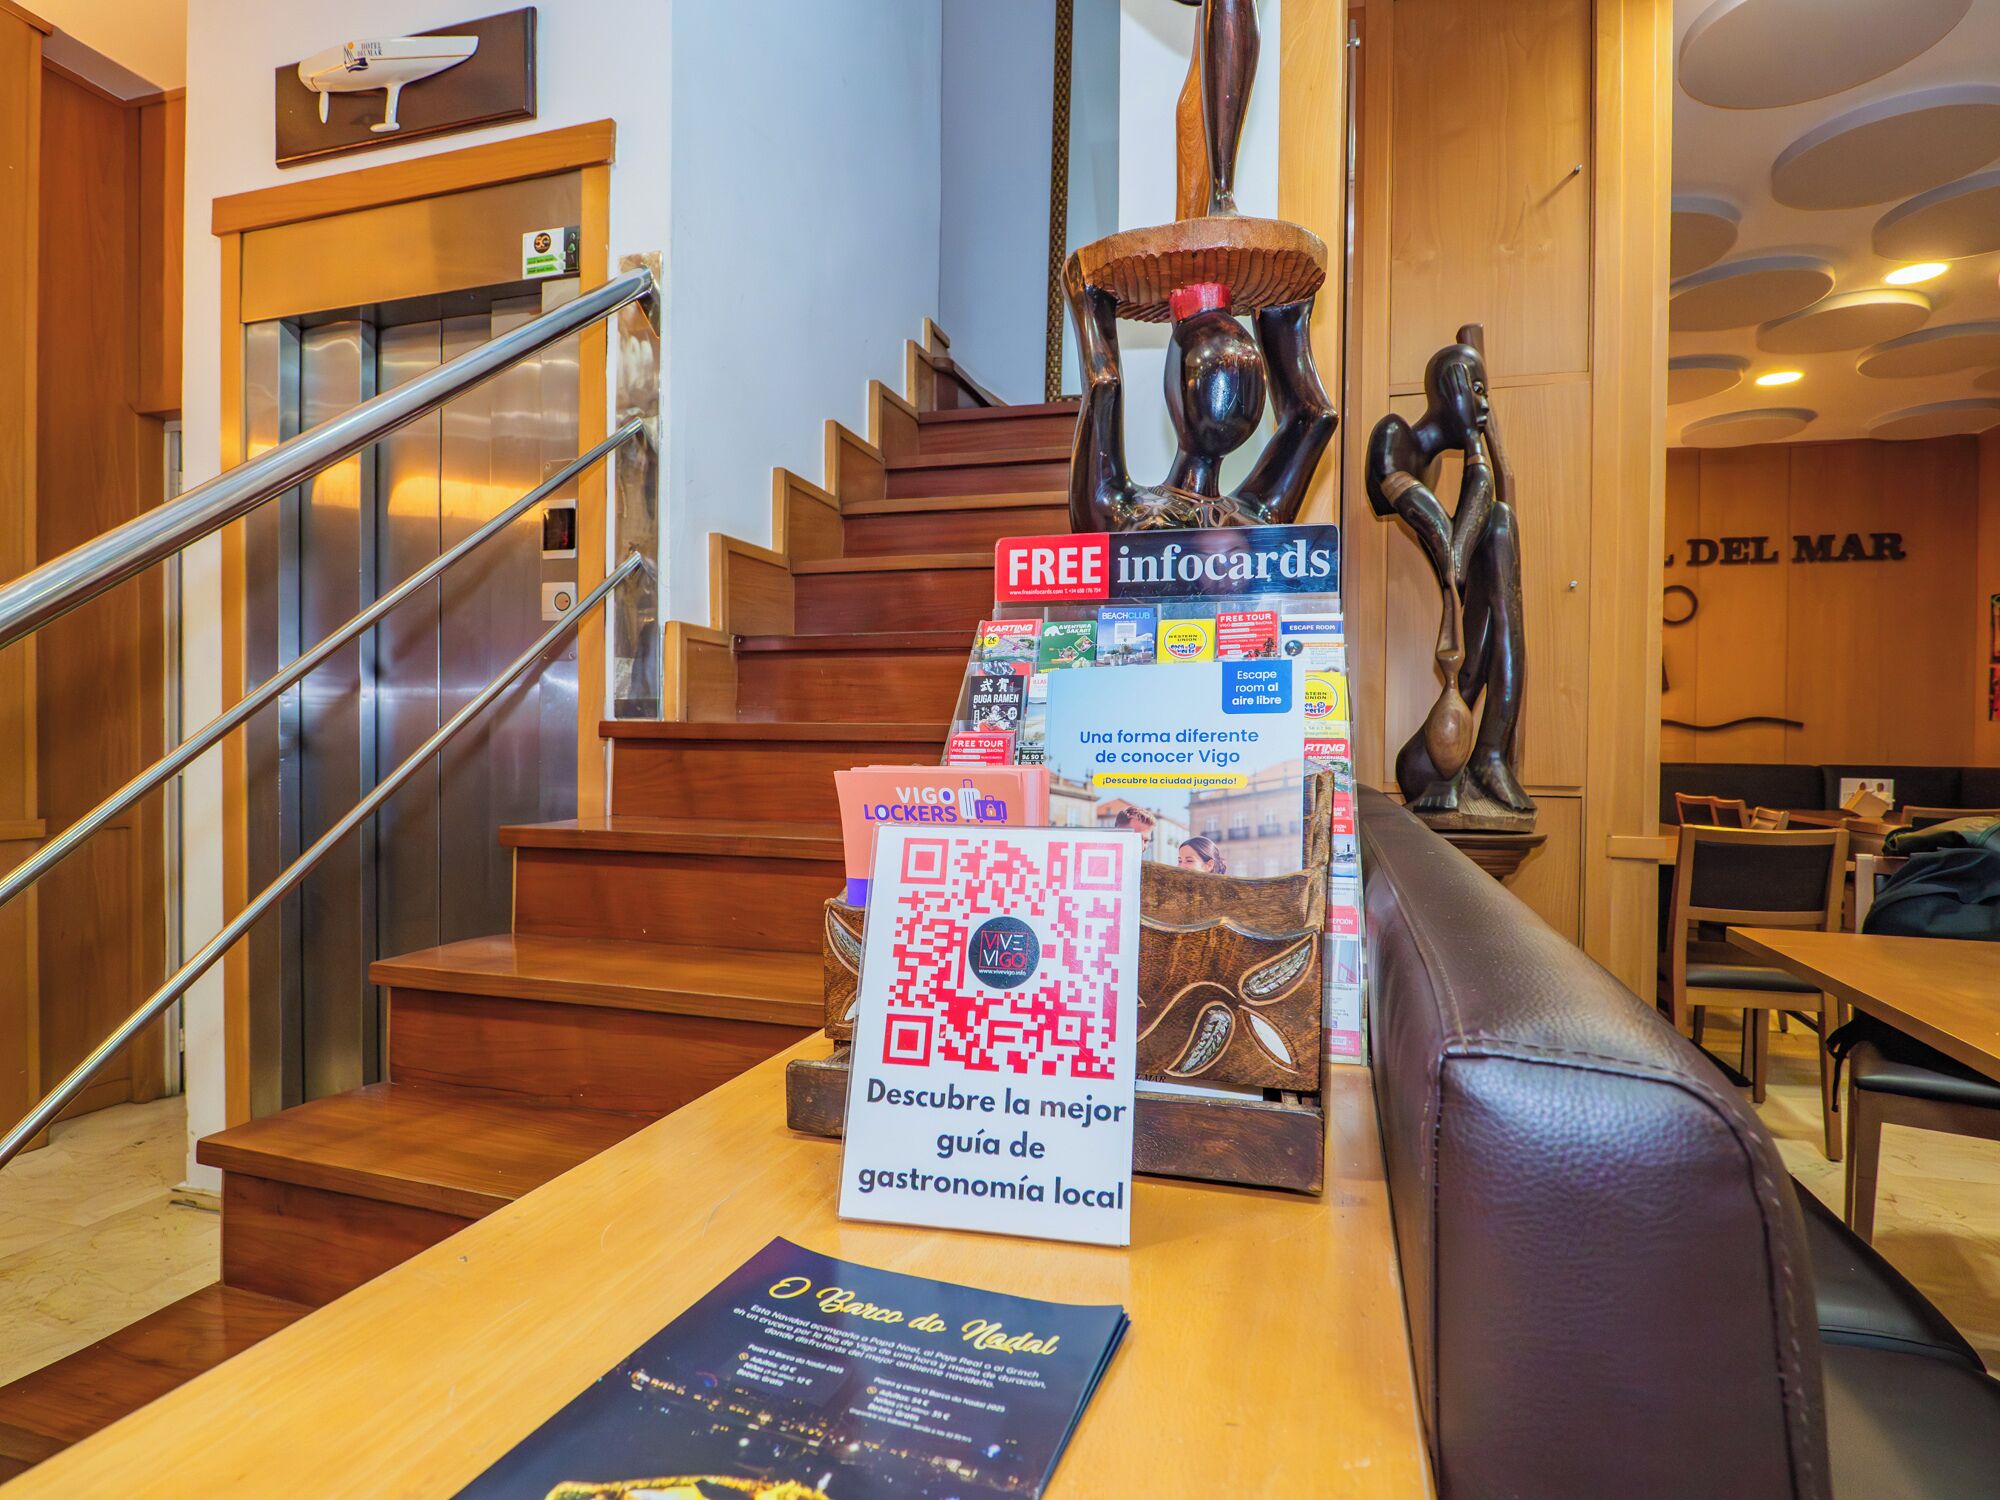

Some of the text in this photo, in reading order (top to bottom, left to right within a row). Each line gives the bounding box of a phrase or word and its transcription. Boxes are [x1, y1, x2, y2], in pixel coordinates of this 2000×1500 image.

[1686, 536, 1779, 567] DEL
[1791, 532, 1907, 564] MAR
[1009, 546, 1102, 586] FREE
[1117, 540, 1331, 583] infocards
[1102, 612, 1151, 620] BEACHCLUB
[1220, 613, 1272, 622] FREE TOUR
[986, 624, 1033, 633] KARTING
[1237, 670, 1277, 682] Escape
[1235, 682, 1279, 693] room al
[973, 693, 1019, 704] BUGA RAMEN
[1231, 694, 1282, 705] aire libre
[952, 739, 1004, 748] FREE TOUR
[1080, 728, 1259, 744] Una forma diferente
[1304, 743, 1346, 754] RTING
[1095, 749, 1240, 767] de conocer Vigo
[1102, 776, 1237, 786] ¡Descubre la ciudad jugando!
[895, 786, 956, 805] VIGO
[863, 803, 958, 823] LOCKERS
[984, 933, 1024, 951] VIVE
[983, 949, 1026, 969] VIGO
[867, 1078, 1127, 1128] Descubre la mejor
[936, 1128, 1046, 1159] guía de
[858, 1168, 1124, 1210] gastronomía local
[768, 1276, 1060, 1355] O Barco do Nadal
[750, 1304, 770, 1315] Esta
[771, 1311, 809, 1326] Navidad
[934, 1352, 957, 1363] Paje
[958, 1357, 982, 1368] Real
[993, 1364, 1004, 1372] al
[1005, 1365, 1040, 1380] Grinch
[758, 1317, 793, 1331] crucero
[793, 1327, 811, 1336] por
[840, 1338, 854, 1346] de
[877, 1347, 891, 1355] de
[892, 1351, 912, 1360] una
[912, 1355, 938, 1367] hora
[948, 1362, 981, 1376] media
[982, 1370, 997, 1379] de
[764, 1326, 996, 1389] donde disfrutarás del mejor ambiente navideño.
